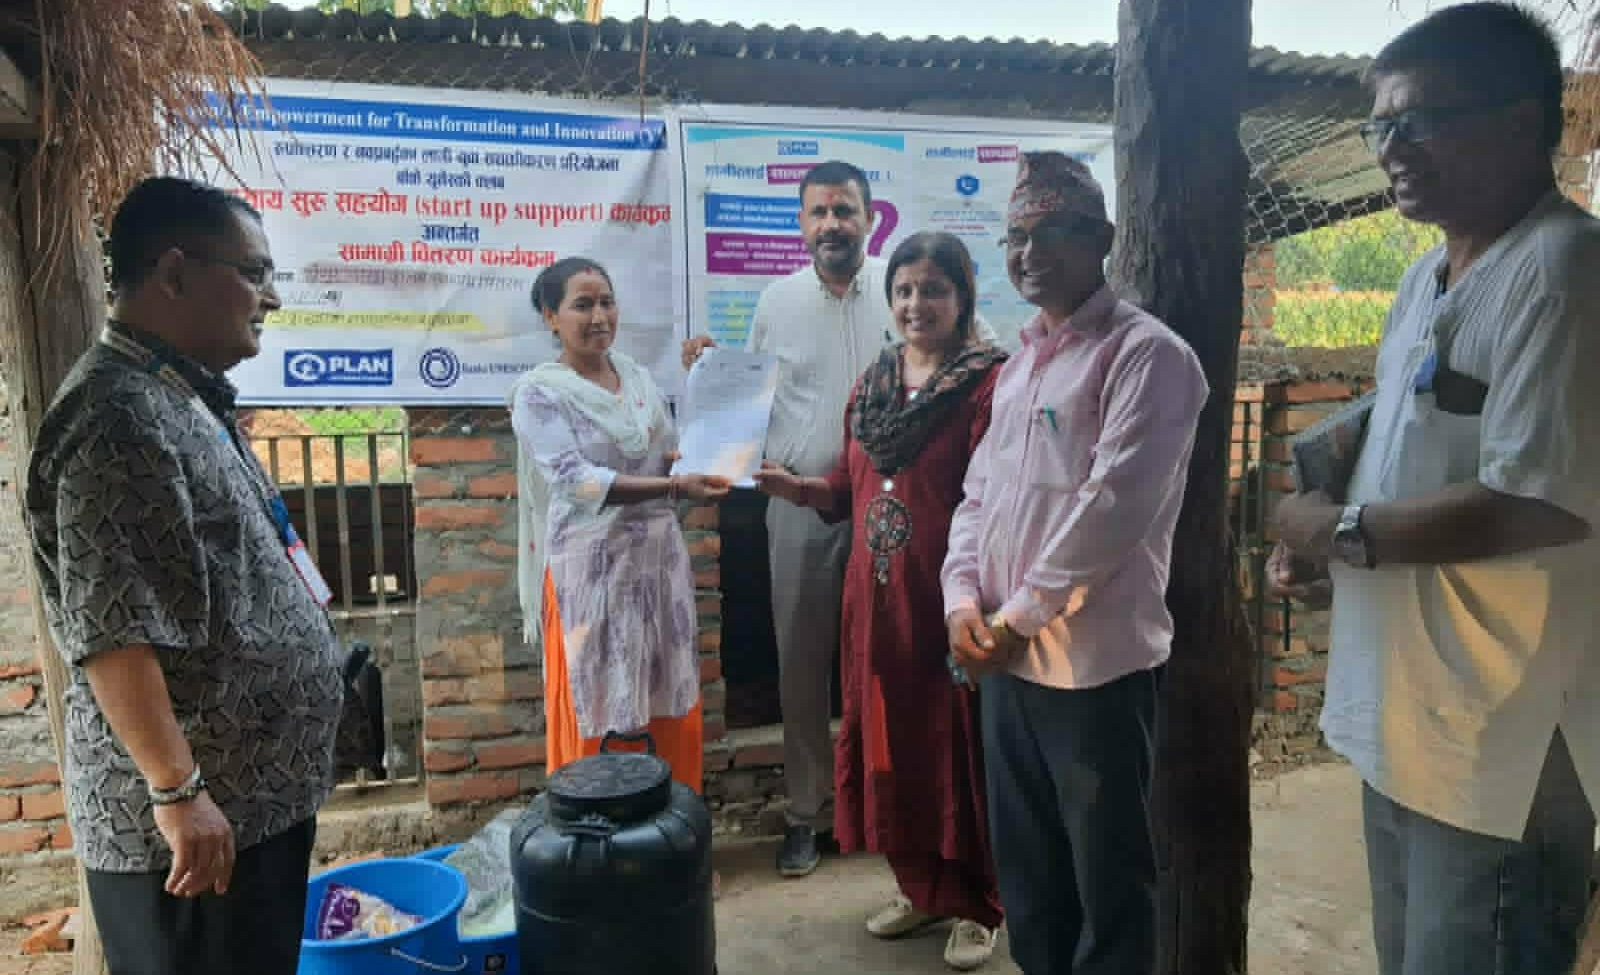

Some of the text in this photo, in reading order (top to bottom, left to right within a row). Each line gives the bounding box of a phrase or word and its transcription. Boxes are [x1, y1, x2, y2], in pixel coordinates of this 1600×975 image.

[242, 104, 362, 127] Empowerment
[367, 110, 392, 129] for
[393, 111, 517, 136] Transformation
[521, 121, 549, 139] and
[554, 122, 636, 141] Innovation
[334, 187, 409, 215] सहयोग
[415, 195, 472, 219] (start
[480, 201, 508, 226] up
[411, 241, 474, 266] वितरण
[328, 356, 389, 373] PLAN
